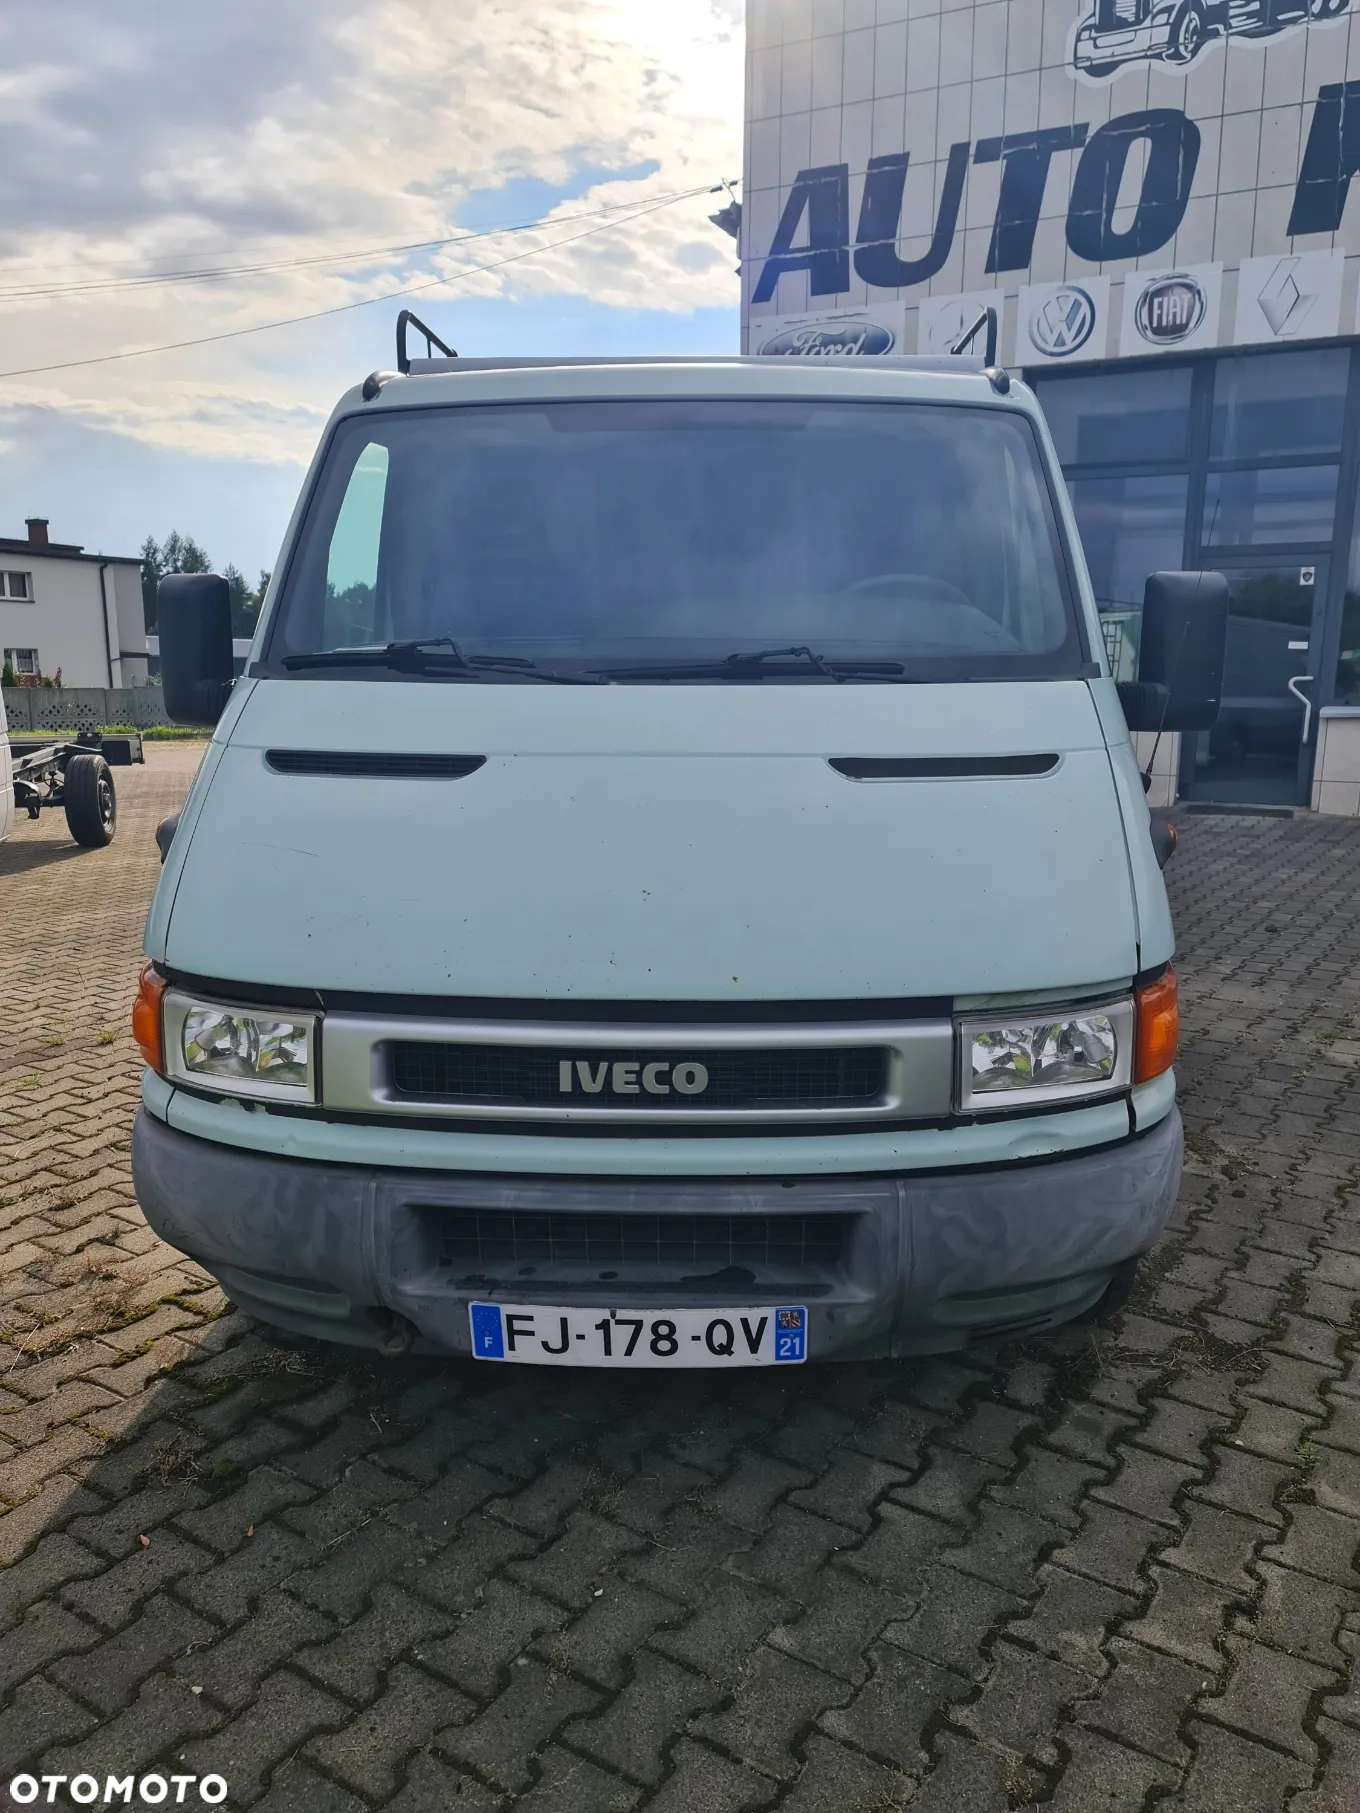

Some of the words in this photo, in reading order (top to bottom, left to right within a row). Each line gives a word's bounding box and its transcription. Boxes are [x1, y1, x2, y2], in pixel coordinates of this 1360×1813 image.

[751, 108, 1200, 303] AUTO
[1153, 293, 1192, 328] FIAT
[559, 1060, 709, 1094] IVECO
[484, 1336, 493, 1349] F
[779, 1337, 800, 1356] 21
